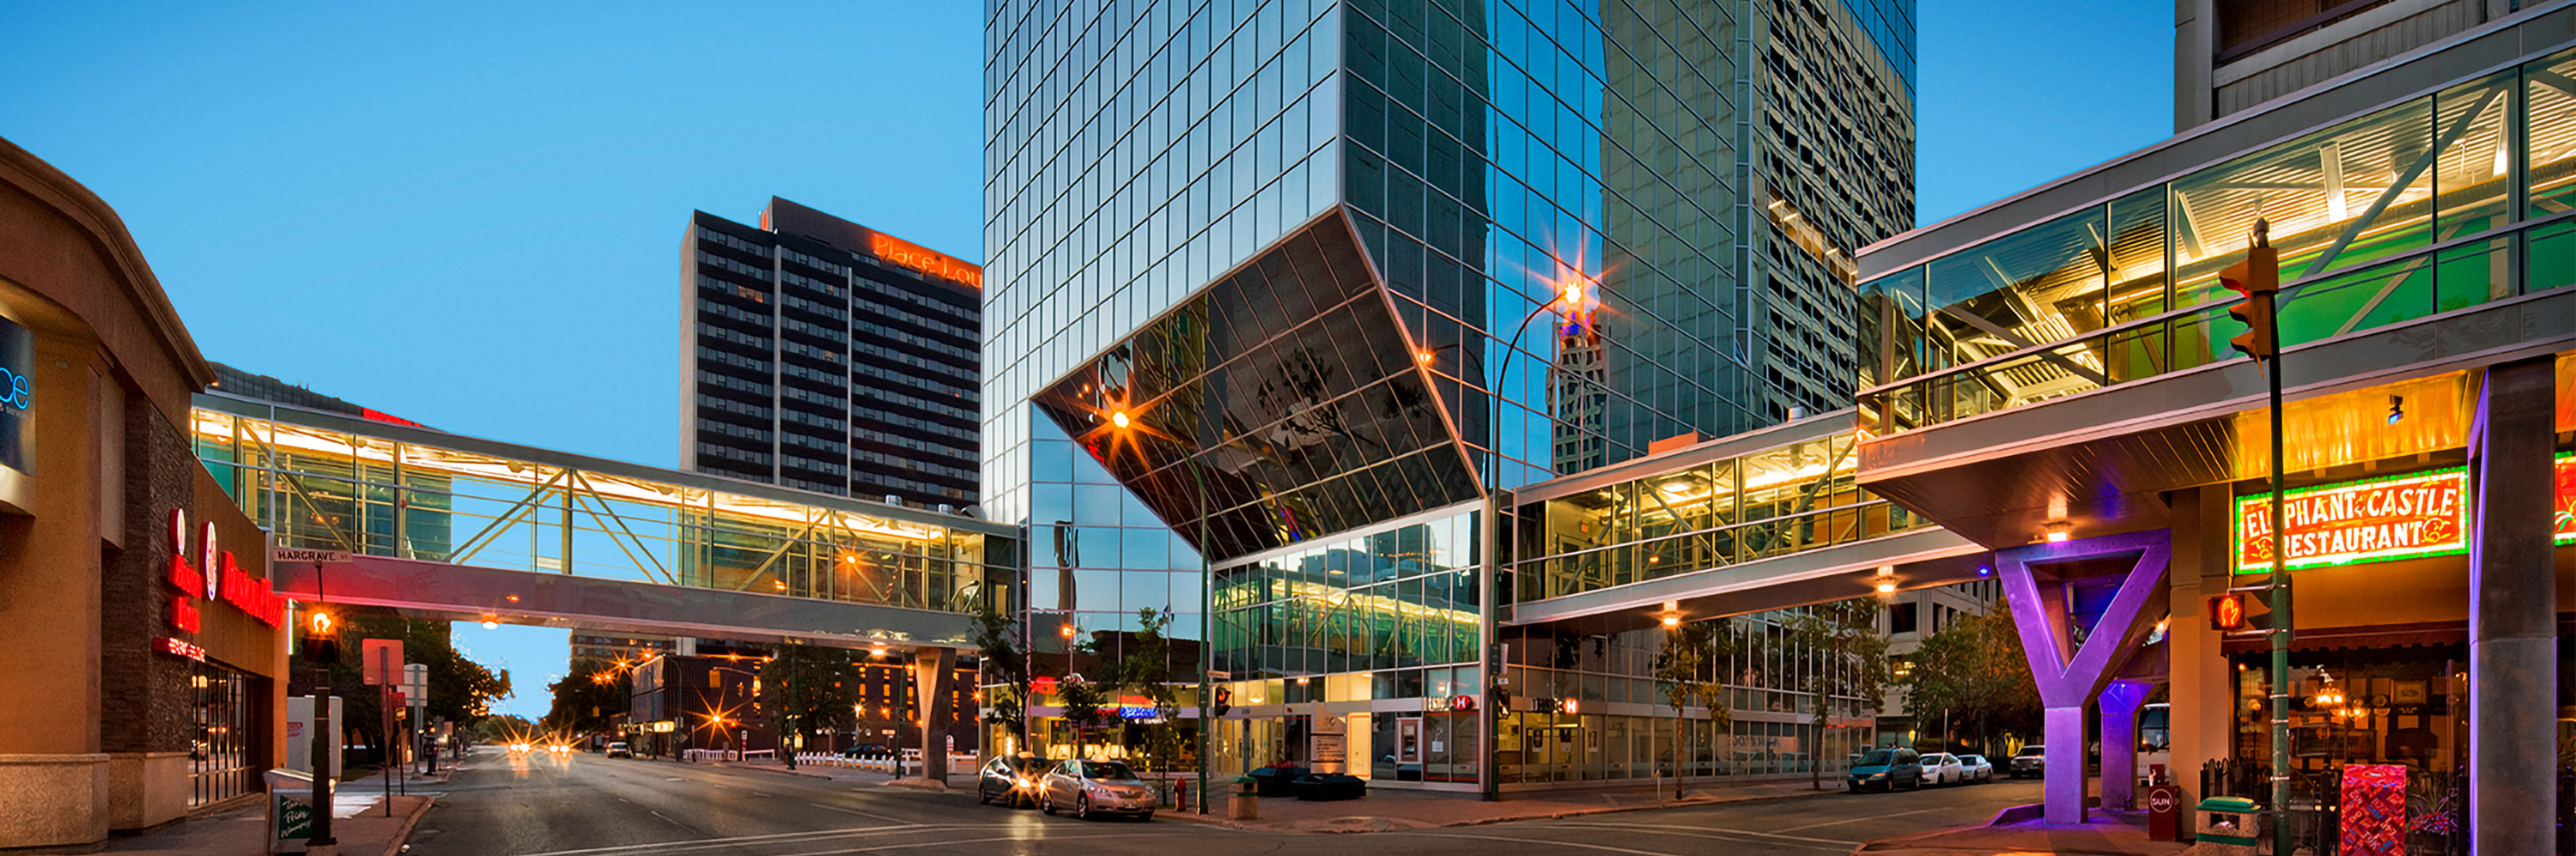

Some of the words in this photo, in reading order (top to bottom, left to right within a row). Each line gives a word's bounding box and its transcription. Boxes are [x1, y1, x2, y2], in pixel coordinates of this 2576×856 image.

[873, 233, 936, 274] Place
[939, 257, 982, 289] Lou
[2366, 488, 2458, 517] CASTLE
[276, 550, 336, 561] HARGRAVE
